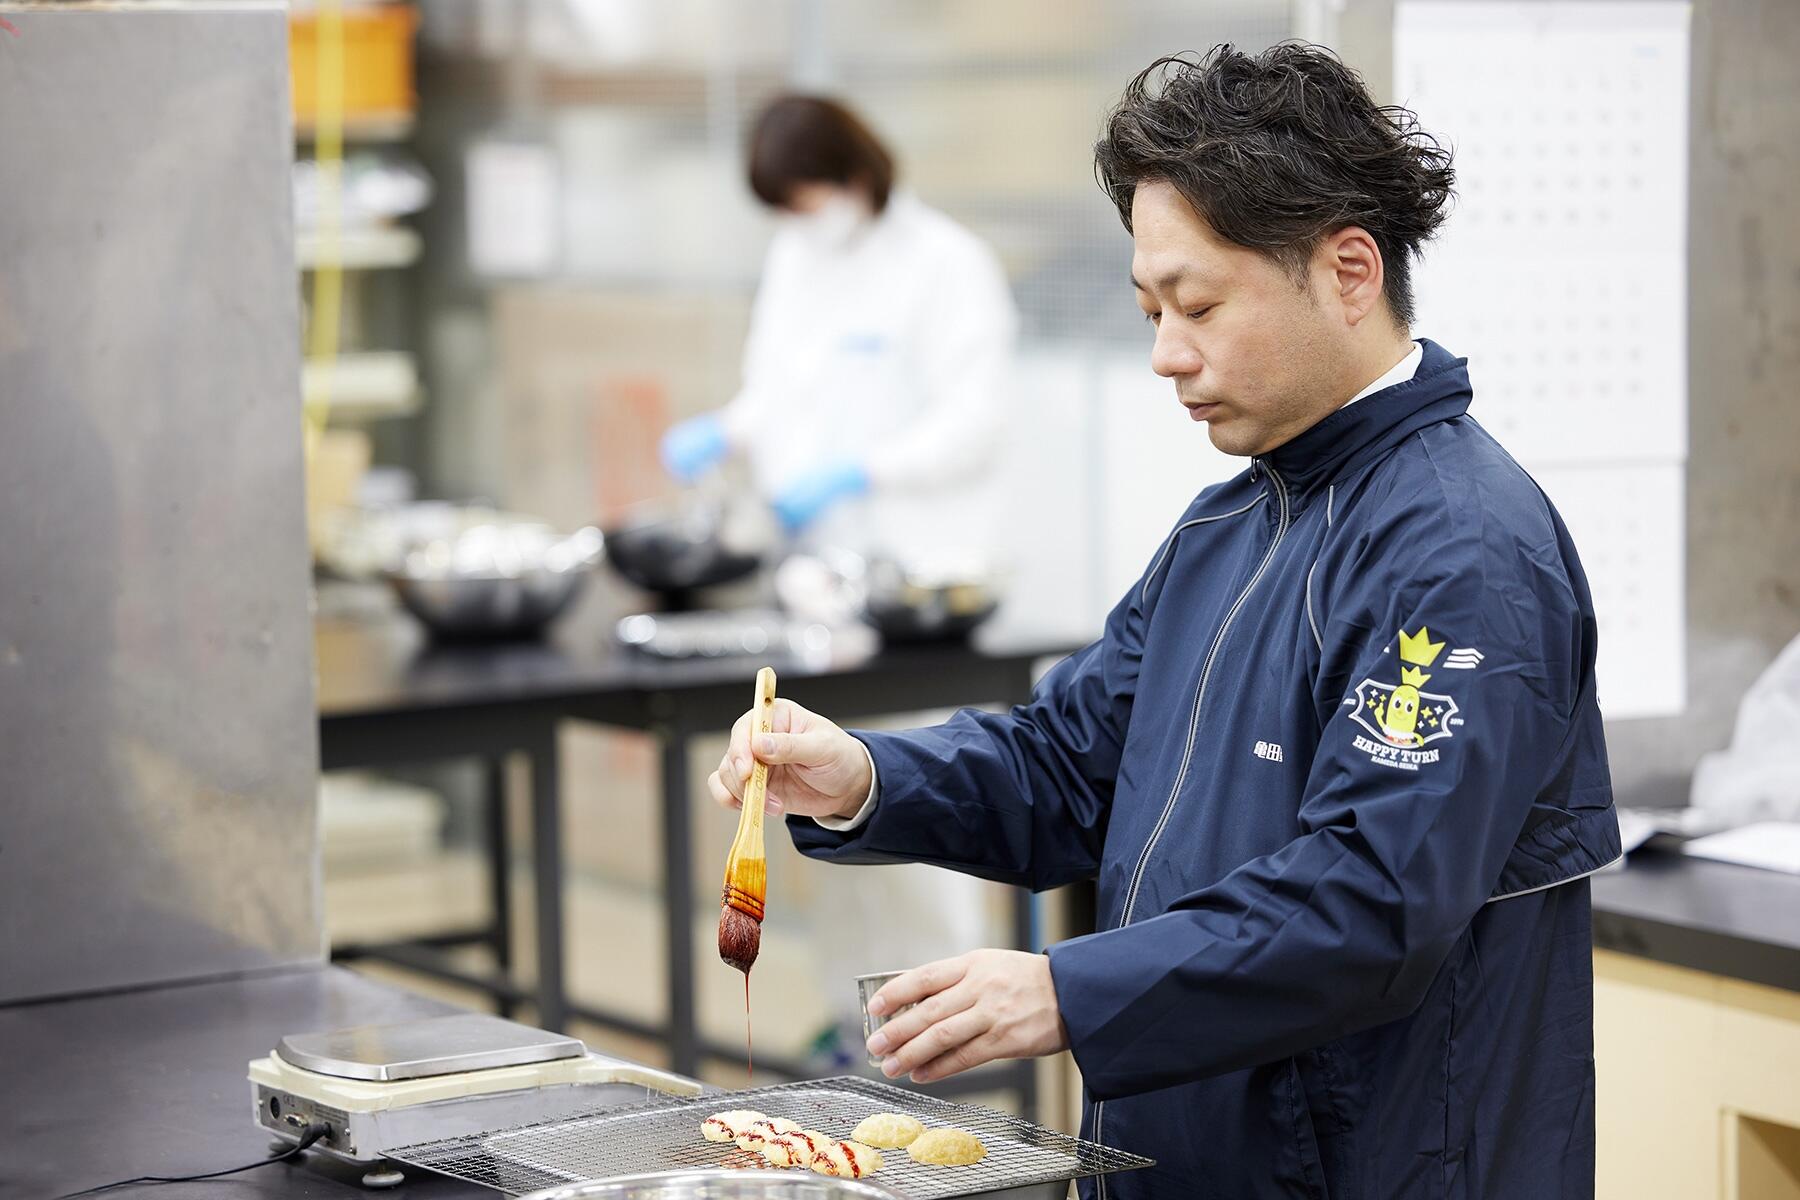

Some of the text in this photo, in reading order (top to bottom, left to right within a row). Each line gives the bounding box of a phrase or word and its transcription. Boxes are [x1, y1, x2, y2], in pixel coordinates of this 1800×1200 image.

[1253, 740, 1283, 762] 亀田
[1352, 734, 1440, 764] HAPPY TURN
